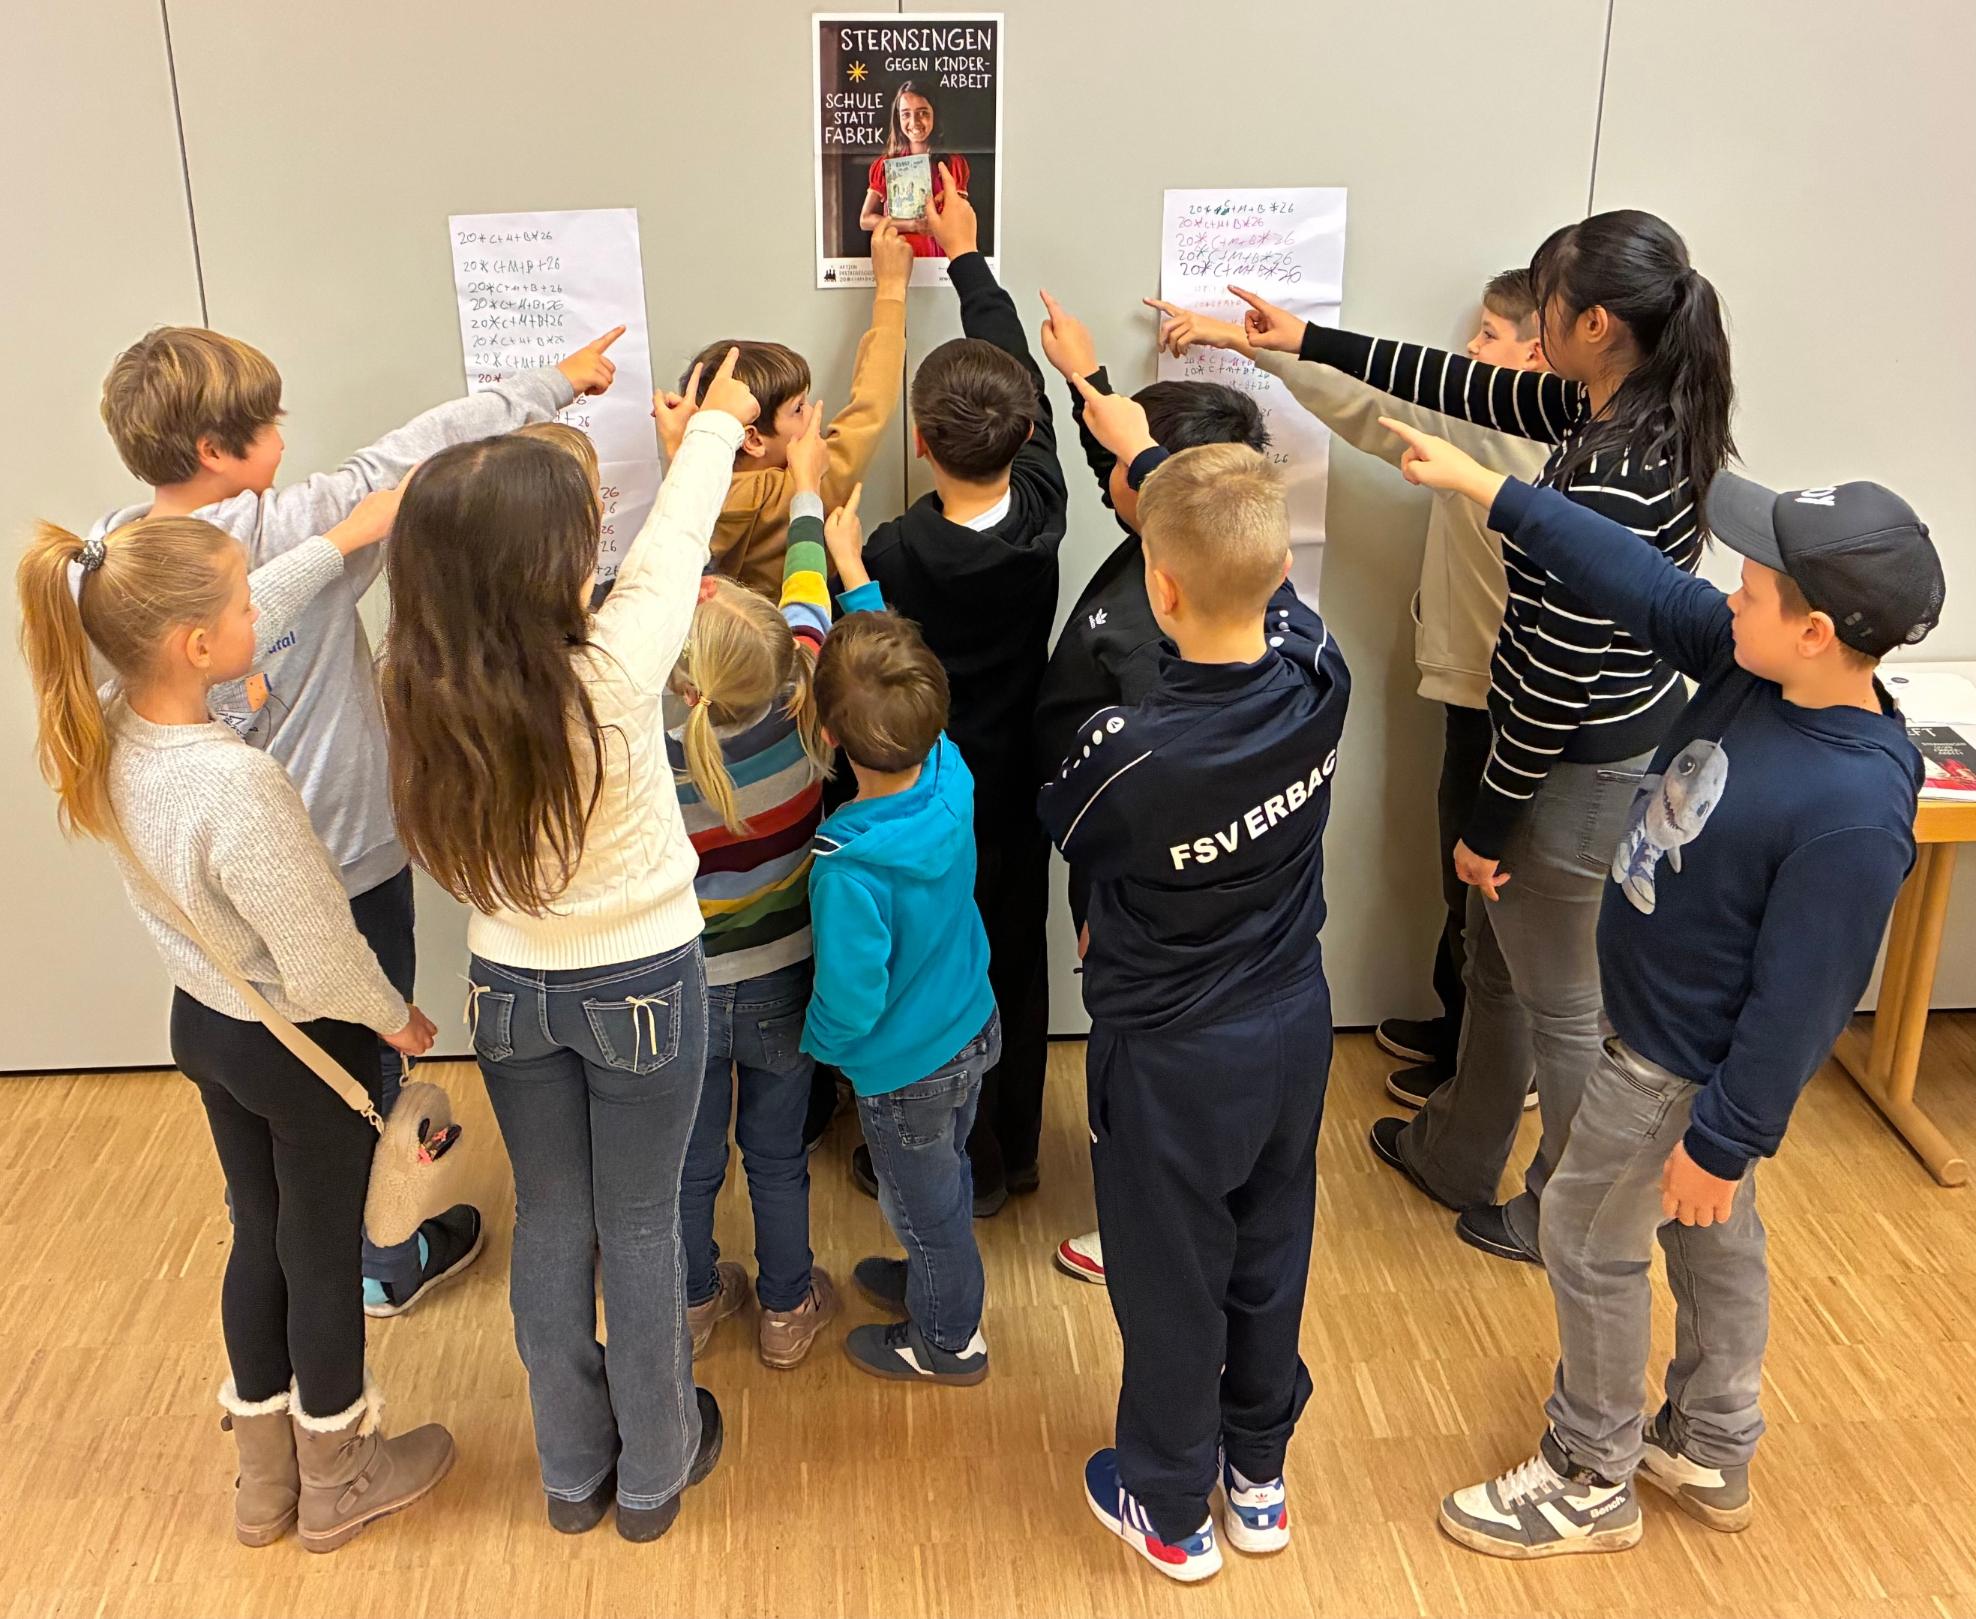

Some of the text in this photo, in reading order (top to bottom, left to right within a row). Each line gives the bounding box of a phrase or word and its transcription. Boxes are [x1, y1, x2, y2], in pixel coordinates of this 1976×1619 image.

[840, 28, 992, 53] STERNSINGEN
[885, 56, 990, 71] GEGEN KINDER-
[940, 73, 992, 88] ARBEIT
[826, 93, 884, 109] SCHULE
[834, 111, 875, 125] STATT
[825, 127, 884, 145] FABRIK
[1170, 821, 1239, 870] FSV
